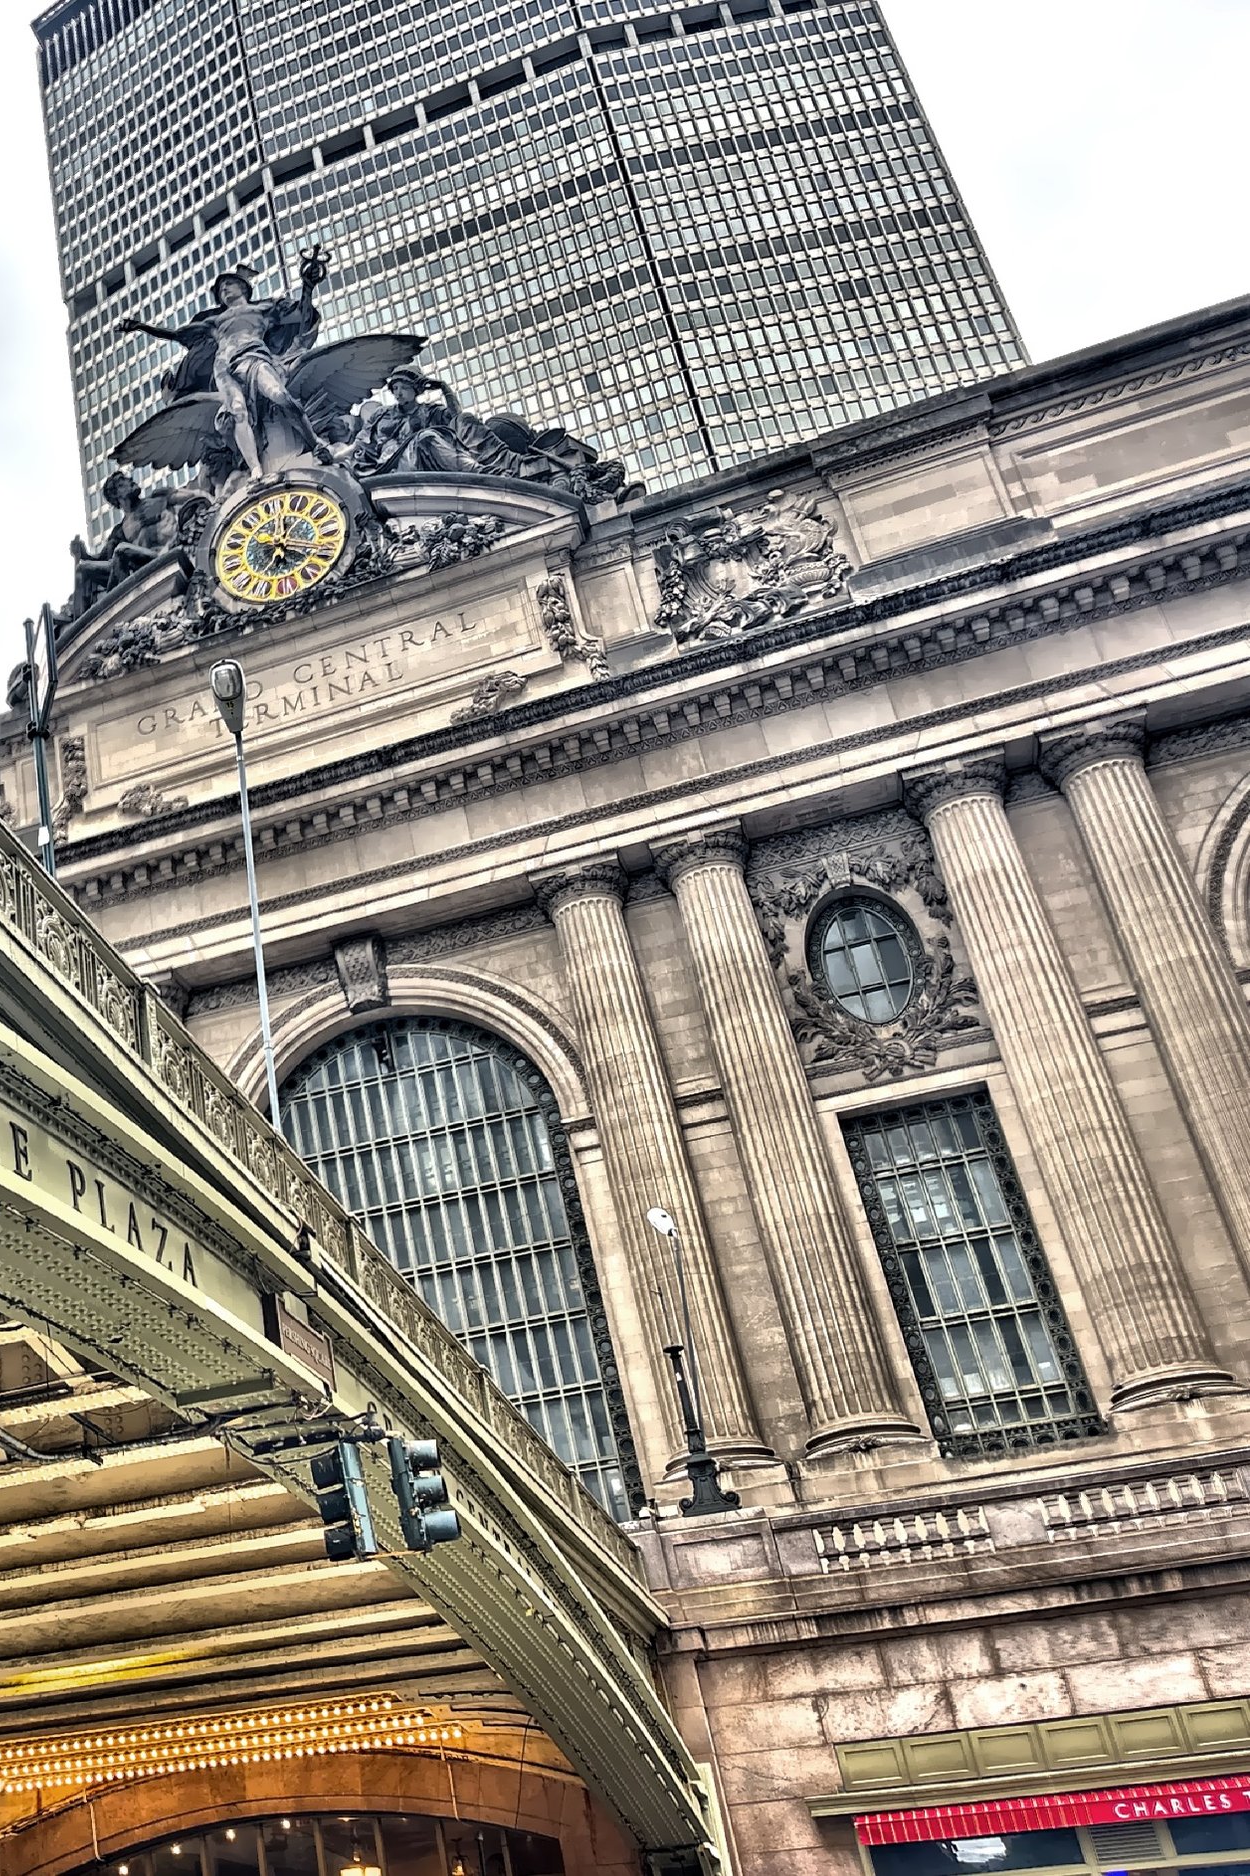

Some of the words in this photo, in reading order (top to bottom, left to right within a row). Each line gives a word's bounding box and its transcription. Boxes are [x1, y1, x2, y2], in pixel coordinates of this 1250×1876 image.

[137, 680, 263, 735] GRAD
[293, 612, 477, 683] CENTRAL
[209, 662, 404, 738] TRMINAL
[68, 1160, 200, 1288] PLAZA
[1114, 1794, 1231, 1818] CHARLES
